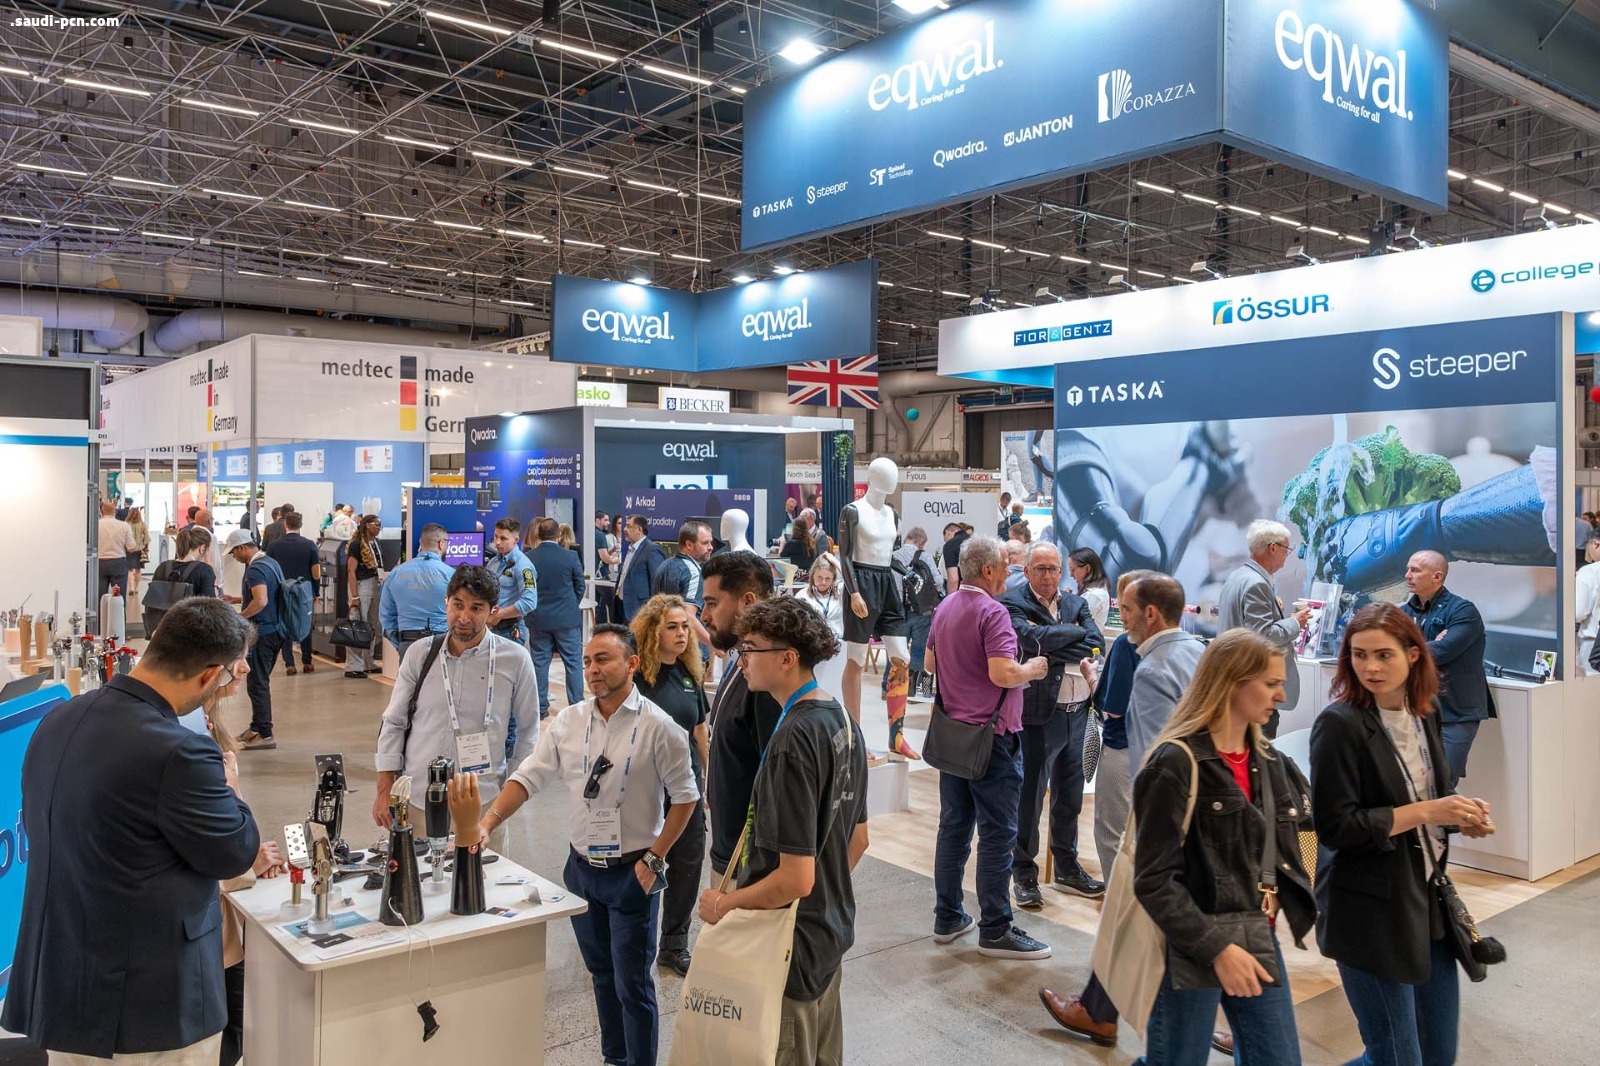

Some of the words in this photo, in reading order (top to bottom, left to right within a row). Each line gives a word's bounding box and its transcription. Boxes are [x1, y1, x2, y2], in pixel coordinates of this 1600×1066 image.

[867, 20, 1004, 111] eqwal.
[1274, 9, 1413, 121] eqwal.
[1123, 81, 1196, 114] CORAZZA
[1336, 96, 1360, 117] Caring
[1360, 105, 1371, 119] for
[1371, 111, 1380, 124] all
[1015, 114, 1073, 143] JANTON
[933, 140, 988, 168] Qwadra.
[888, 169, 914, 180] Technology
[816, 181, 848, 198] steeper
[1501, 262, 1594, 283] college
[1237, 294, 1329, 322] ÖSSUR
[581, 308, 675, 341] eqwal.
[742, 297, 812, 341] eqwal.
[1063, 322, 1111, 338] GENTZ
[321, 359, 393, 378] medtec
[425, 366, 474, 383] made
[1409, 350, 1527, 378] steeper
[190, 367, 207, 387] medtec
[213, 360, 229, 381] made
[213, 389, 219, 406] in
[425, 389, 440, 407] in
[577, 386, 611, 400] asko
[680, 397, 724, 412] BECKER
[213, 415, 238, 433] Germany
[471, 428, 497, 445] Qwadra.
[662, 440, 718, 461] eqwal.
[527, 457, 553, 465] International
[554, 457, 567, 465] leader
[568, 456, 573, 464] of
[527, 467, 547, 476] CAD/CAM
[548, 467, 567, 475] solutions
[906, 471, 927, 480] Fyous
[416, 499, 437, 507] Design
[636, 496, 656, 507] Arkad
[924, 499, 966, 517] eqwal.
[653, 517, 676, 529] podiatry
[684, 995, 742, 1021] SWEDEN
